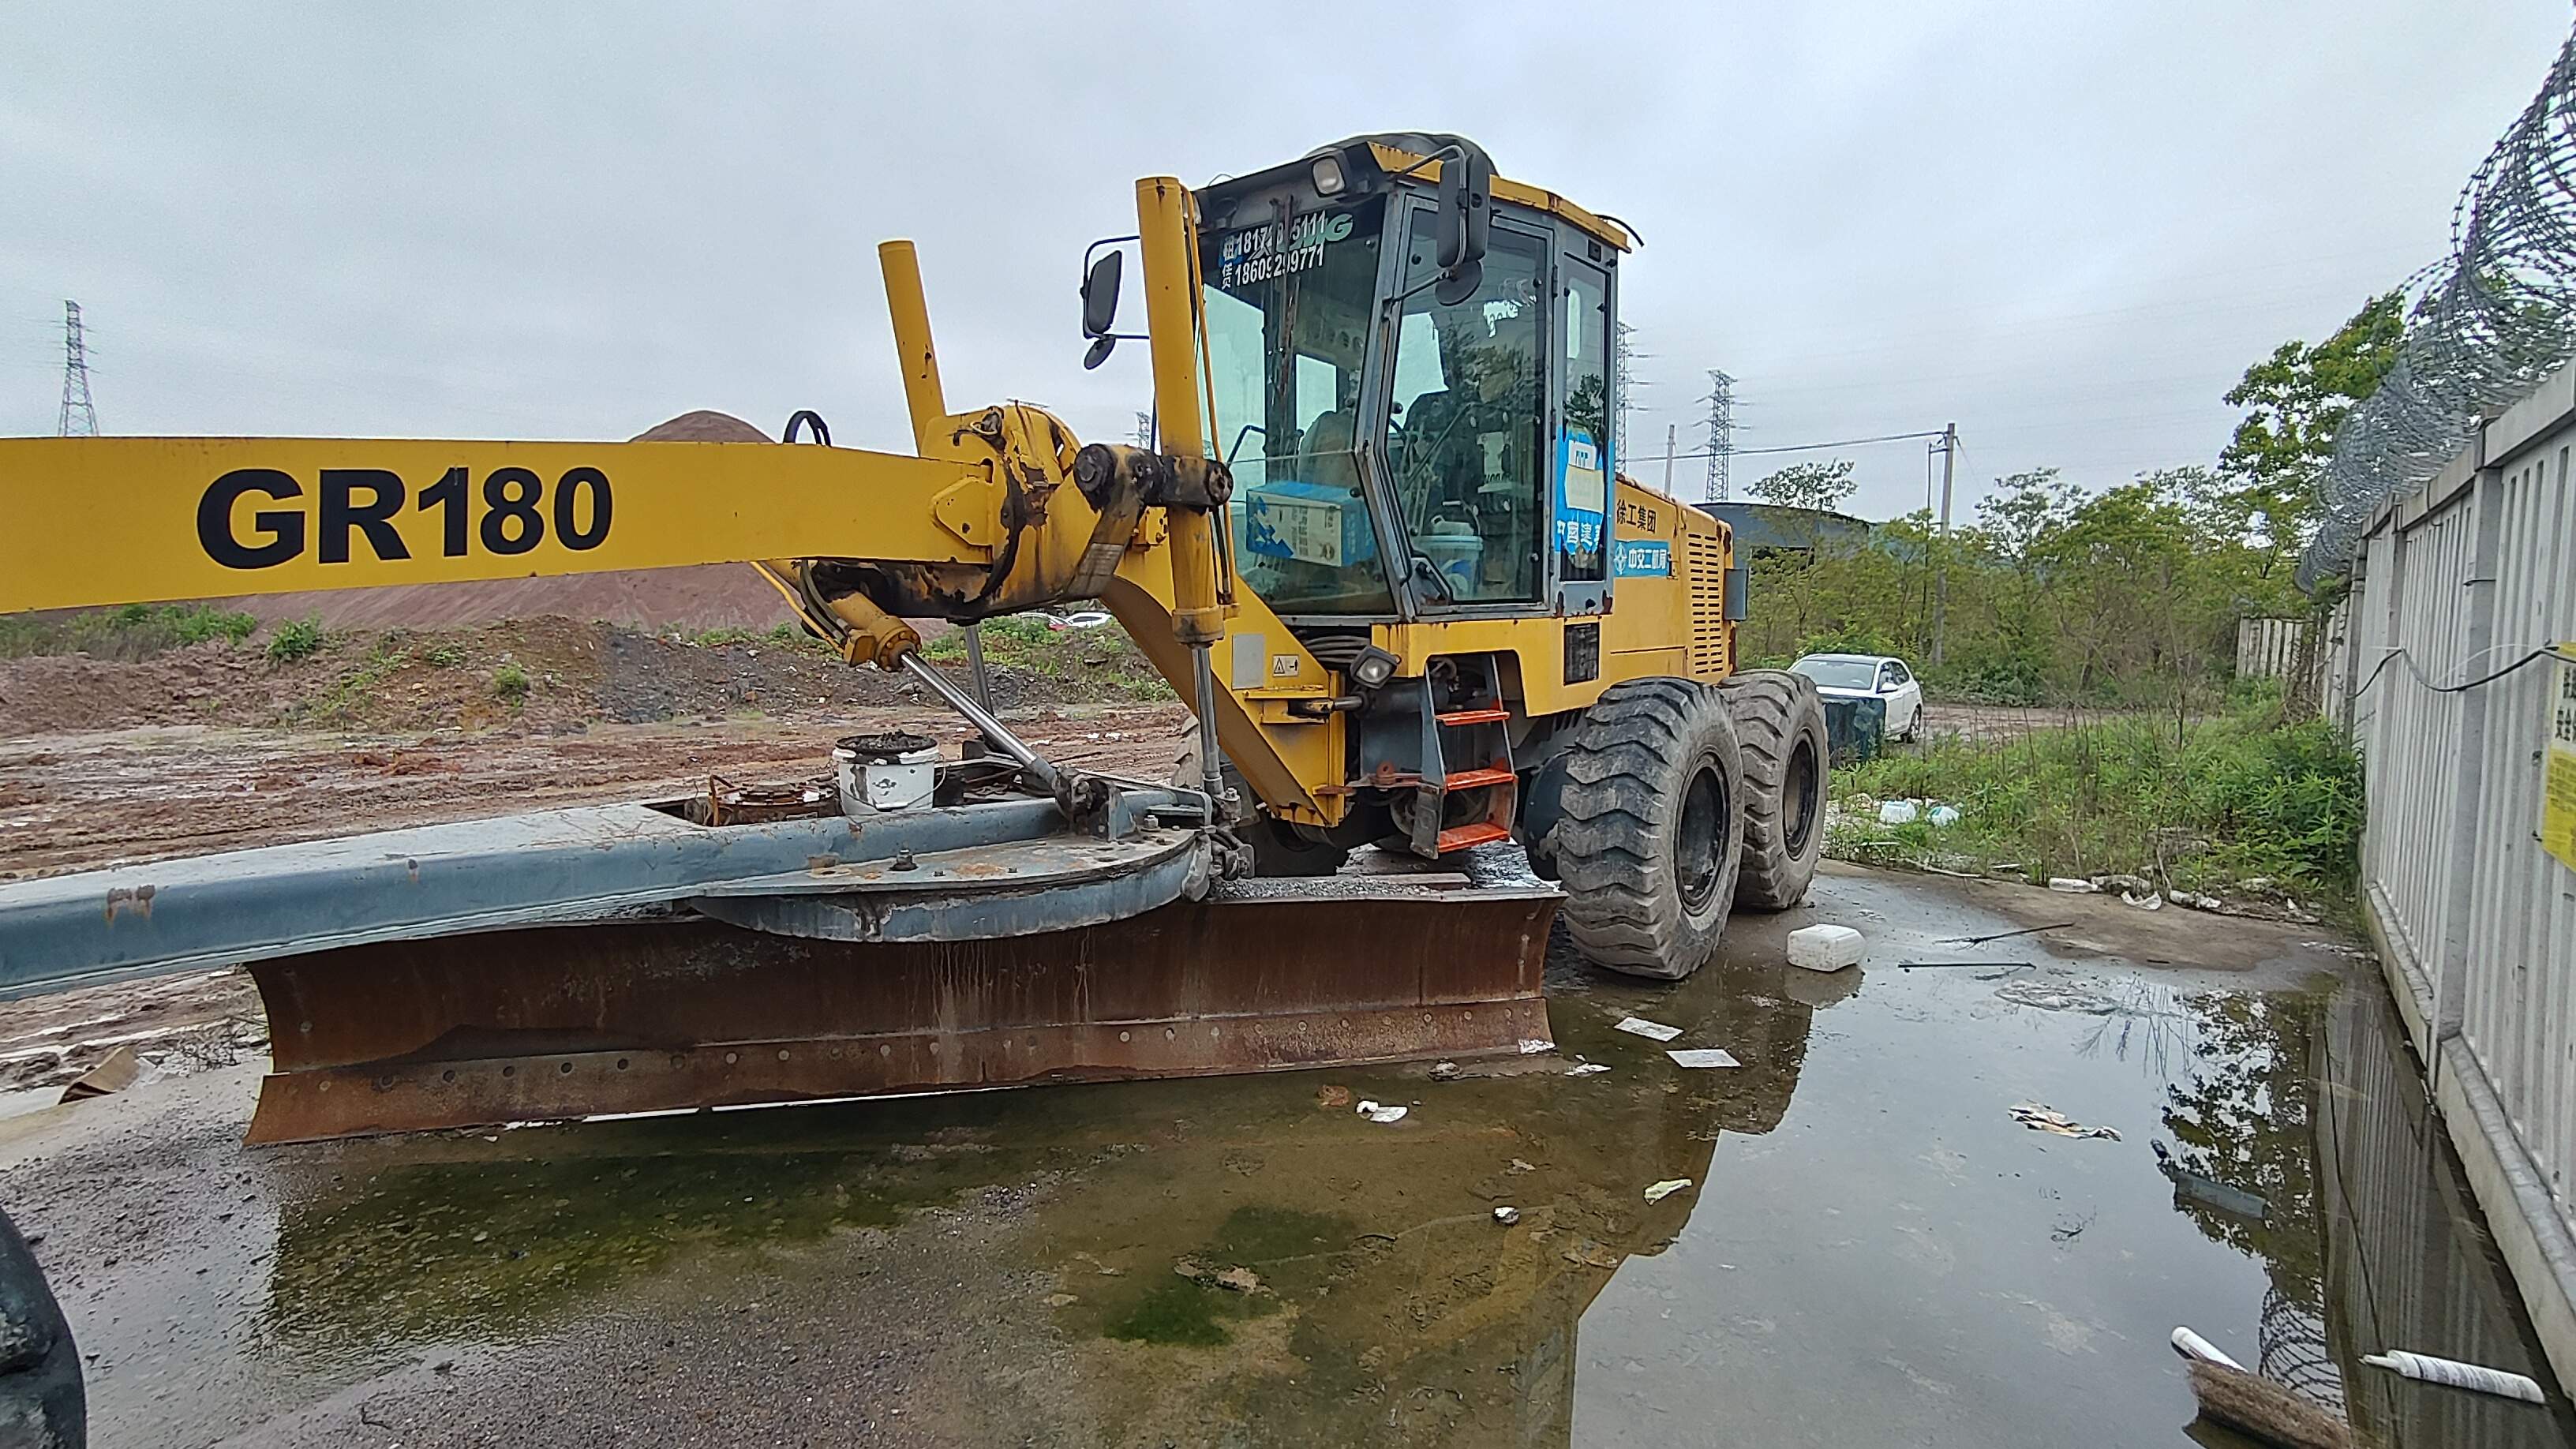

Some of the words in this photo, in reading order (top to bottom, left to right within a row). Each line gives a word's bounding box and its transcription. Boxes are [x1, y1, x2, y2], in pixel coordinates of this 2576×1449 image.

[197, 466, 613, 570] GR180
[1616, 498, 1657, 534] 徐工集团
